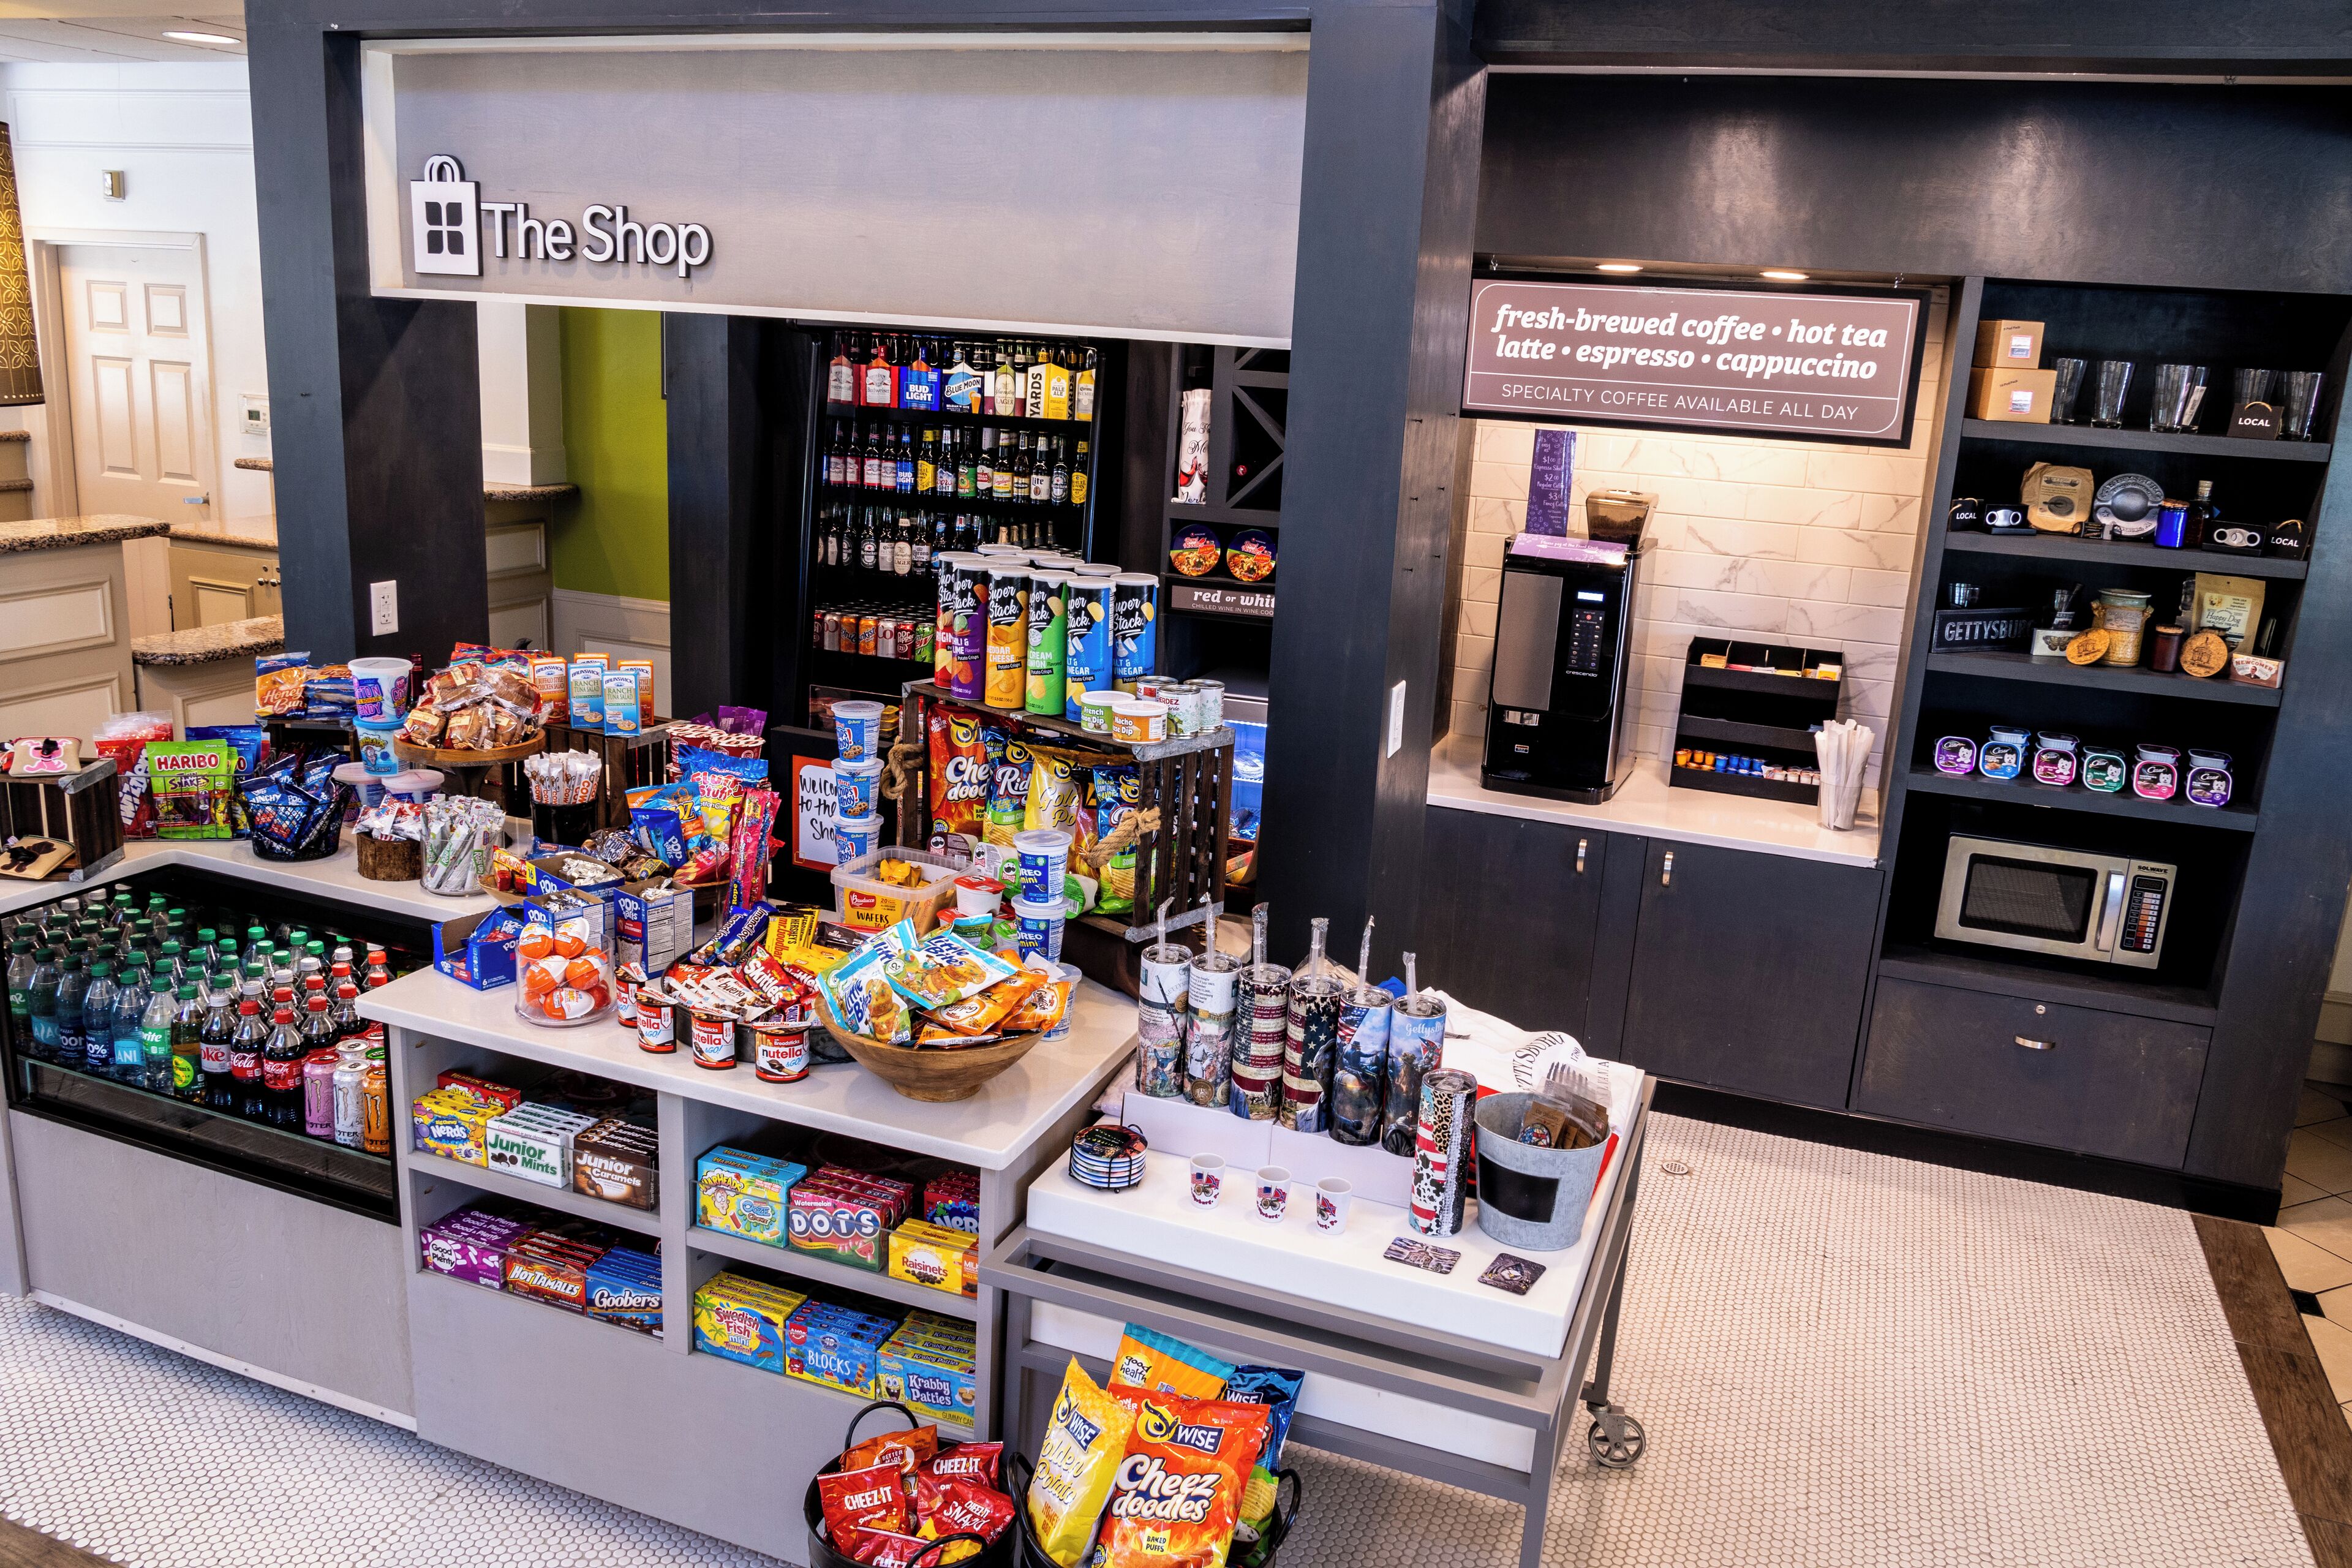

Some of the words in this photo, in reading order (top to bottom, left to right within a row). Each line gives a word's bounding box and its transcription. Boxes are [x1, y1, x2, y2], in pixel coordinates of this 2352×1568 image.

[481, 202, 576, 261] The
[582, 203, 714, 278] Shop
[1491, 304, 1678, 337] fresh-brewed
[1681, 316, 1765, 345] coffee
[1787, 318, 1833, 345] hot
[1841, 324, 1887, 348] tea
[1496, 335, 1553, 360] latte
[1576, 341, 1695, 369] espresso
[1716, 352, 1878, 380] cappuccino
[946, 383, 962, 395] BLUE
[963, 379, 980, 390] MOON
[1030, 372, 1042, 417] YARDS
[906, 393, 932, 401] LIGHT
[1501, 383, 1595, 402] SPECIALTY
[1600, 390, 1668, 407] COFFEE
[1674, 396, 1774, 415] AVAILABLE
[1779, 402, 1814, 417] ALL
[1822, 405, 1858, 420] DAY
[2237, 417, 2271, 428] LOCAL
[1955, 511, 1977, 520] LOCAL
[2270, 536, 2299, 548] LOCAL
[989, 582, 1016, 601] Super
[1194, 590, 1221, 603] red
[2206, 612, 2227, 622] Happy
[2228, 615, 2241, 624] Dog
[897, 632, 914, 643] Pepper
[989, 654, 1014, 663] CHEESE
[2236, 660, 2274, 672] NEWCOMER
[264, 688, 304, 704] Honey
[274, 699, 304, 714] Bun
[1084, 706, 1104, 715] French
[1093, 716, 1104, 725] Dip
[1115, 716, 1133, 726] Nacho
[1121, 726, 1133, 736] Dip
[157, 753, 219, 770] HARIBO
[710, 767, 742, 776] CHARMS
[578, 780, 590, 803] COW
[715, 803, 731, 813] Candy
[799, 799, 812, 813] to
[814, 801, 837, 818] the
[605, 839, 625, 851] Chips
[527, 869, 533, 879] 16
[2137, 865, 2168, 873] SOLWAVE
[857, 911, 889, 924] WAFERS
[930, 937, 969, 956] Little
[930, 947, 965, 967] Bites
[717, 981, 745, 997] bueno
[744, 961, 783, 1005] Skittles
[846, 979, 862, 1012] Little
[762, 1047, 802, 1059] nutella
[1570, 1047, 1581, 1063] 1780
[516, 1108, 544, 1120] Junior
[545, 1115, 560, 1124] Mints
[525, 1102, 554, 1114] Junior
[489, 1134, 546, 1160] Junior
[521, 1158, 557, 1175] Mints
[576, 1150, 633, 1175] Junior
[591, 1168, 642, 1186] Caramels
[699, 1173, 744, 1193] WARHEADS
[742, 1201, 771, 1216] OOZE
[793, 1199, 832, 1208] Watermelon
[747, 1213, 770, 1224] Chewz
[790, 1208, 881, 1238] DOTS
[921, 1230, 949, 1241] Raisinets
[431, 1243, 452, 1256] Good
[432, 1253, 456, 1268] Plenty
[901, 1257, 948, 1278] Raisinets
[594, 1288, 660, 1310] Goobers
[714, 1307, 760, 1330] Swedish
[725, 1320, 752, 1338] Fish
[723, 1341, 753, 1355] Tropical
[728, 1334, 750, 1346] mini
[808, 1350, 851, 1376] BLOCKS
[912, 1353, 934, 1363] Krabby
[934, 1357, 959, 1366] Patties
[1125, 1355, 1152, 1371] good
[1119, 1364, 1147, 1384] health
[908, 1373, 951, 1396] Krabby
[911, 1388, 952, 1406] Patties
[942, 1411, 962, 1423] GUMMY
[1069, 1414, 1099, 1447] WISE
[1177, 1426, 1219, 1452] WISE
[881, 1450, 903, 1461] BETTER
[1116, 1454, 1222, 1499] Cheez
[1110, 1496, 1212, 1523] doodles
[1145, 1543, 1164, 1552] PUFFS
[1147, 1536, 1167, 1544] BAKED
